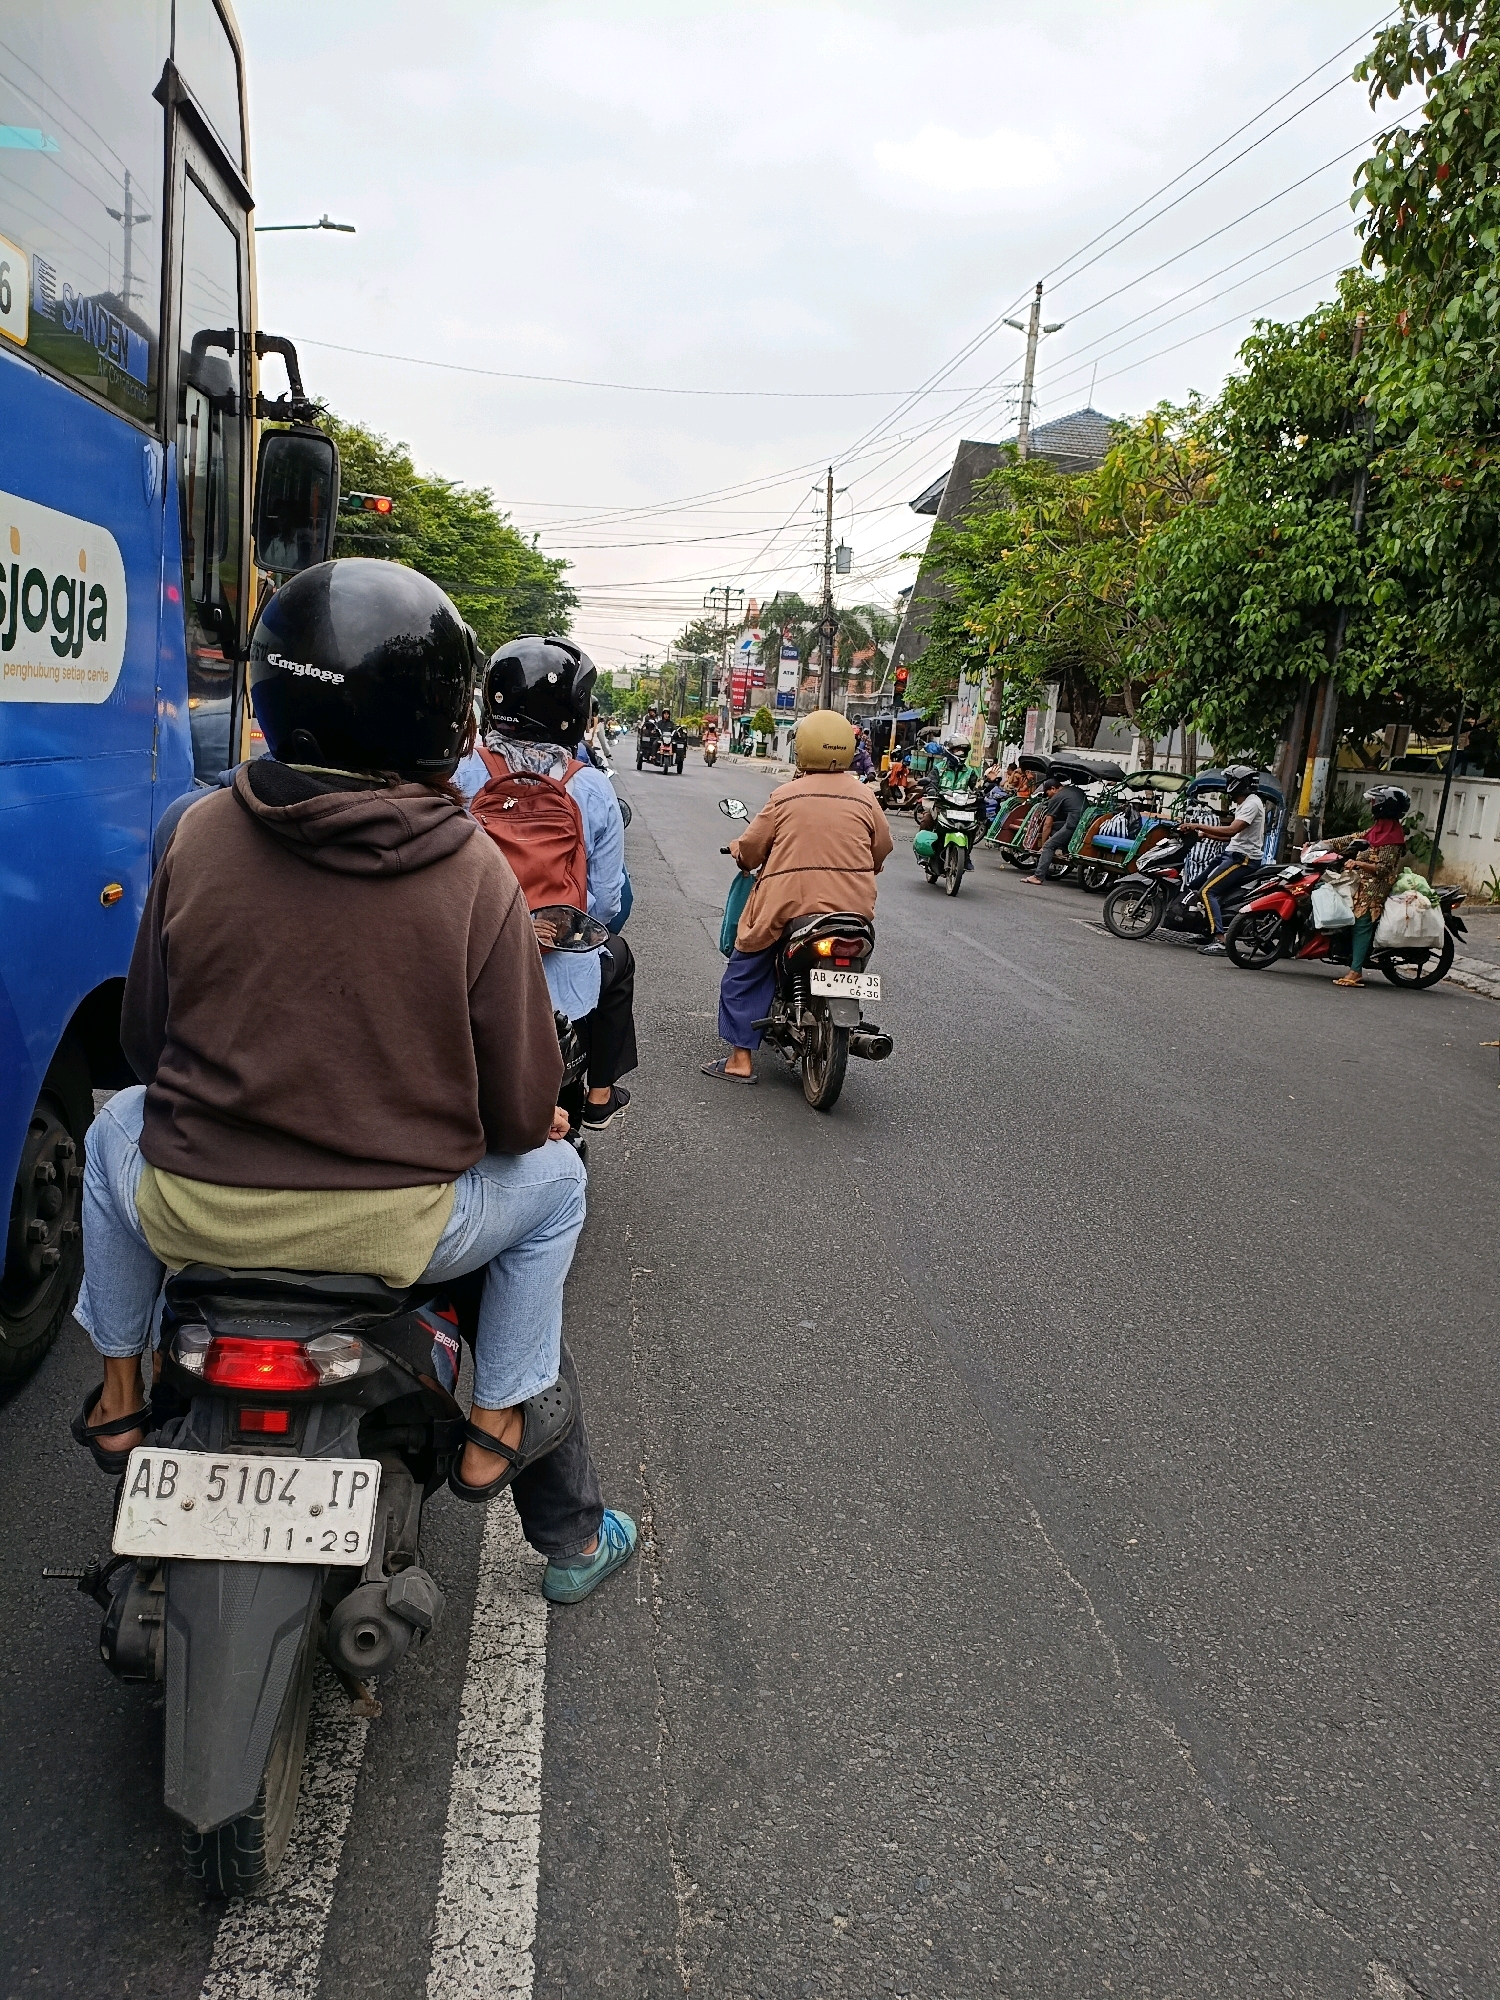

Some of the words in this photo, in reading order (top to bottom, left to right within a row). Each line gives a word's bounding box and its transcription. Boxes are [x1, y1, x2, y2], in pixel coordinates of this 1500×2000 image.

[0, 260, 12, 315] 6
[62, 283, 132, 371] SANDEN
[3, 661, 60, 683] penghubung
[62, 665, 85, 685] setiap
[86, 666, 109, 683] cerita
[267, 653, 345, 686] Cargloss
[492, 713, 520, 723] HONDA
[812, 971, 826, 982] AB
[833, 973, 859, 985] 4767
[866, 976, 879, 988] JS
[130, 1458, 180, 1500] AB
[207, 1464, 301, 1505] 5104
[328, 1469, 370, 1509] IP
